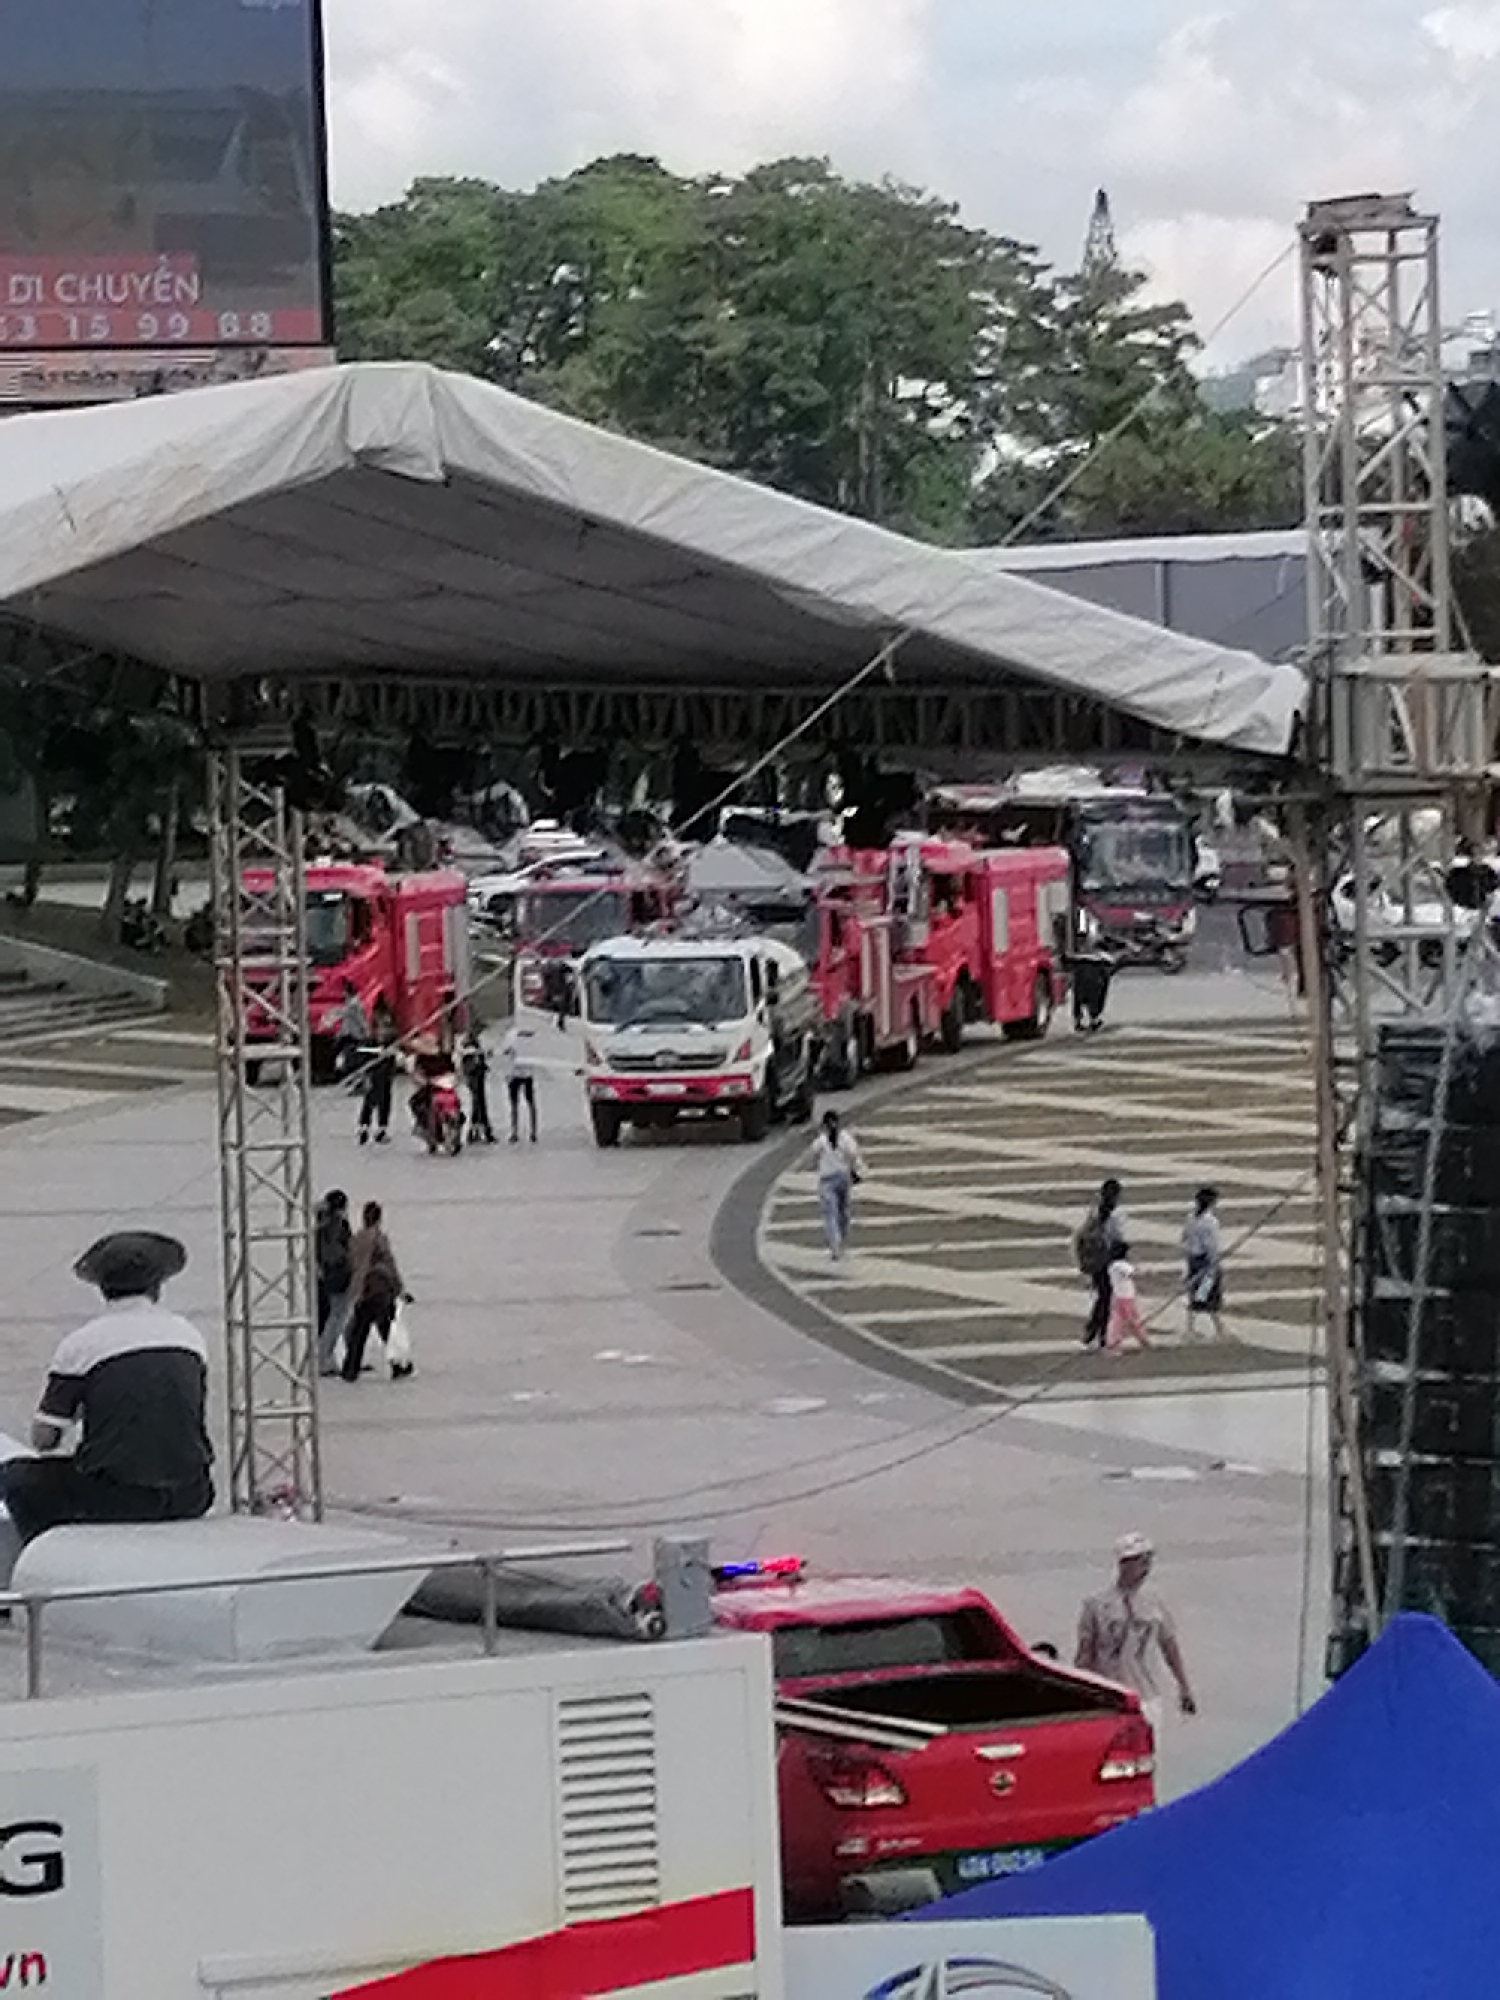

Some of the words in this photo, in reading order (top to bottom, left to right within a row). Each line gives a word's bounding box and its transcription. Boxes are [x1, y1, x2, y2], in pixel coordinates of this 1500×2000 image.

[55, 254, 201, 304] CHUYỂN
[65, 314, 110, 342] 15
[137, 312, 189, 340] 99
